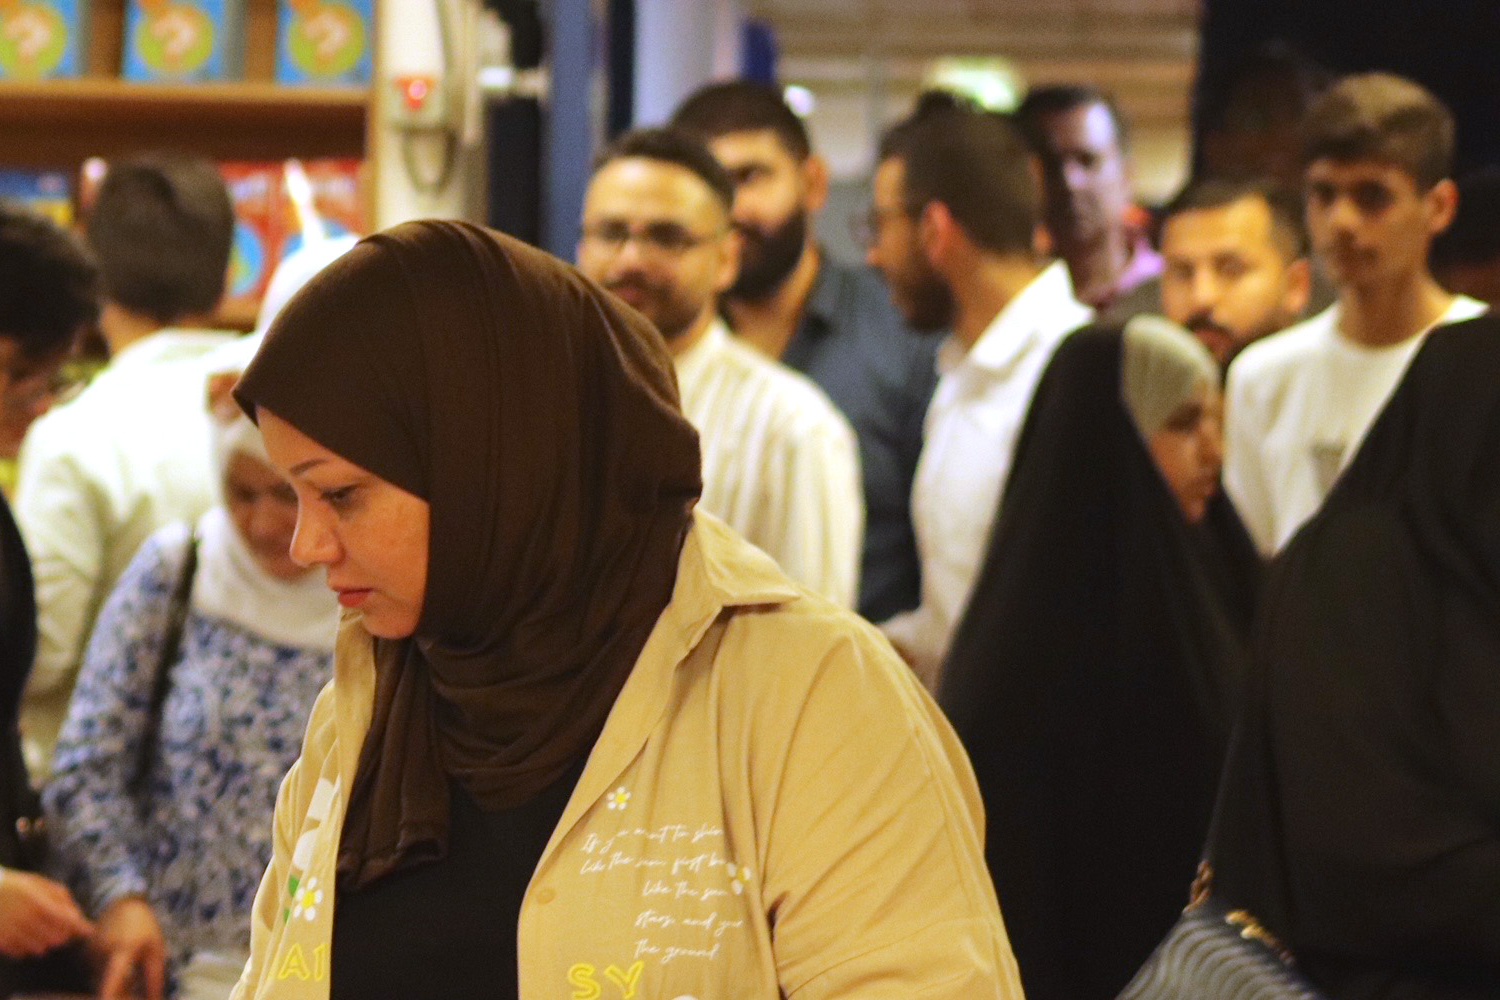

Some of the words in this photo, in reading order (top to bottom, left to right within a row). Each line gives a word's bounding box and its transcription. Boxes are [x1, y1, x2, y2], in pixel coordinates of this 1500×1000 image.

[642, 880, 672, 897] like
[682, 912, 718, 930] and
[660, 943, 721, 965] ground
